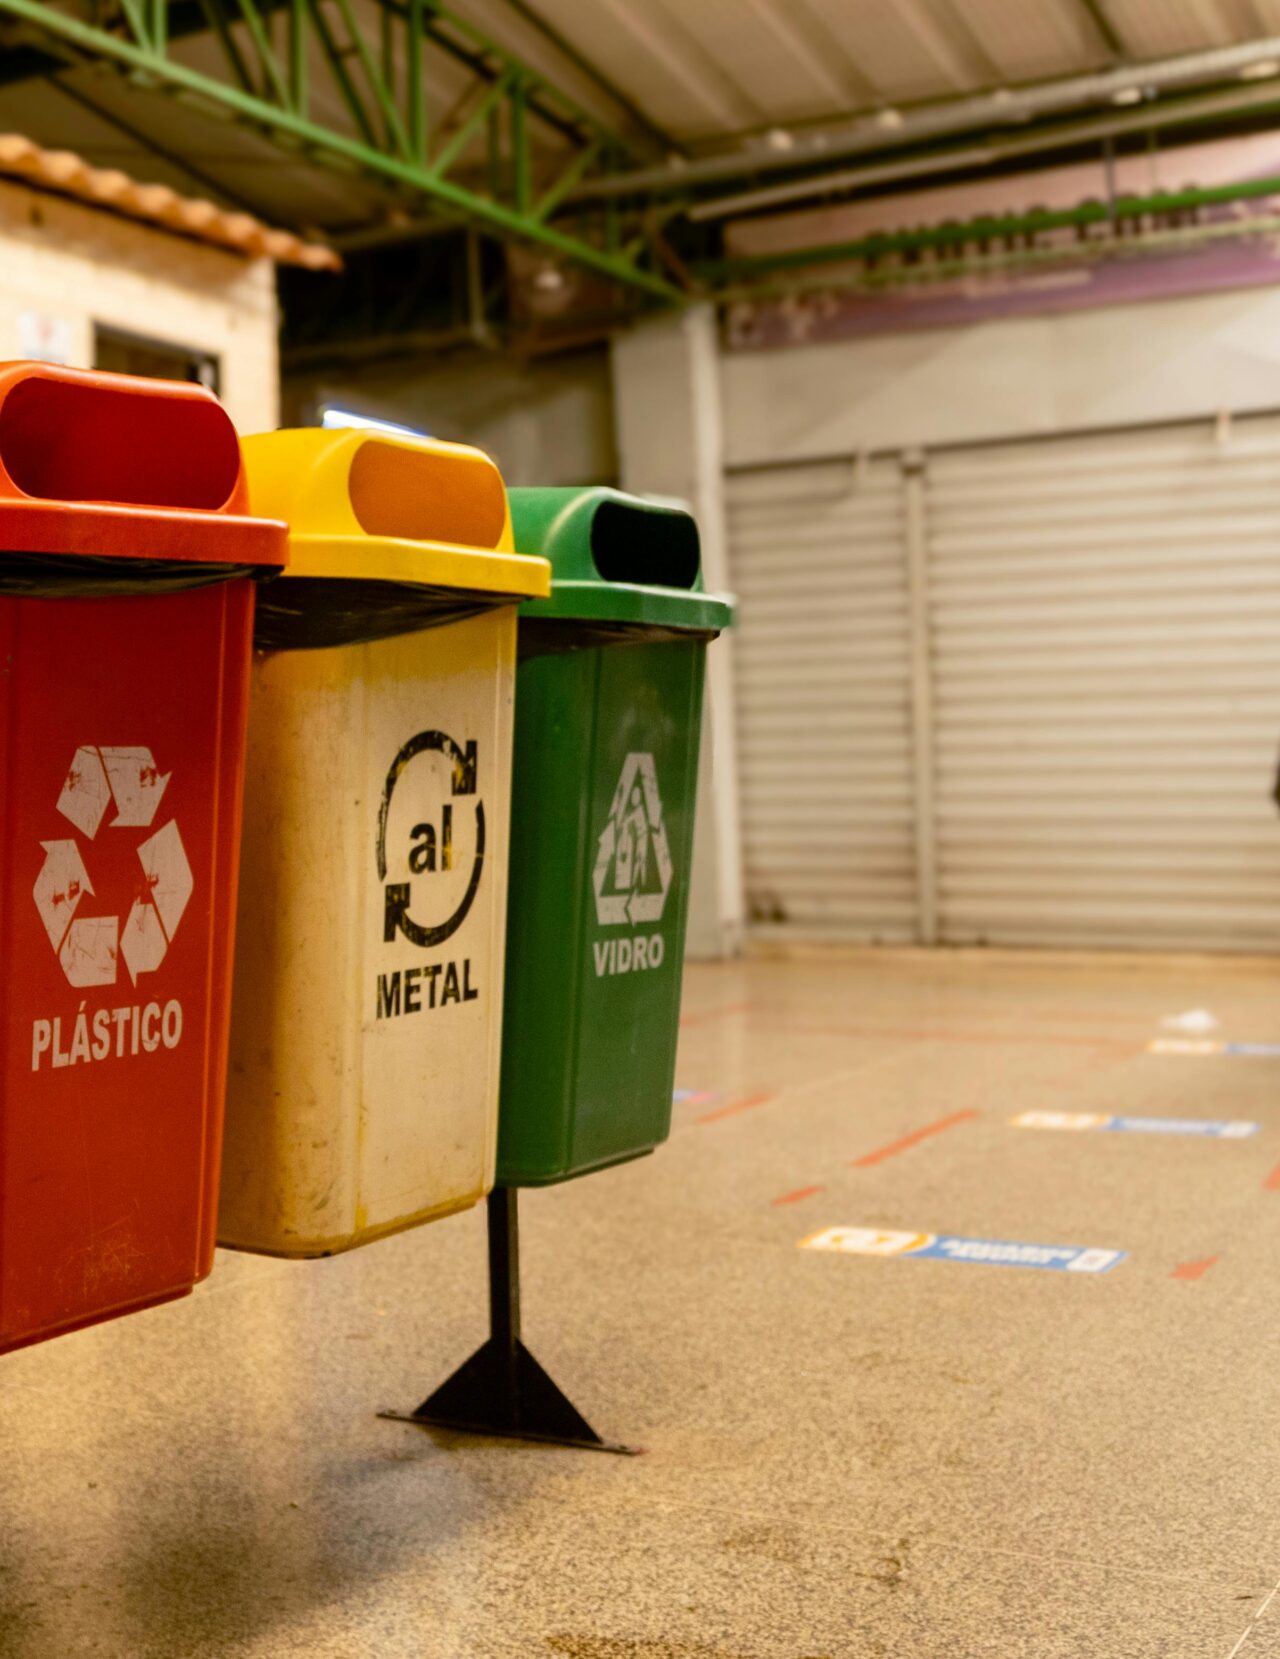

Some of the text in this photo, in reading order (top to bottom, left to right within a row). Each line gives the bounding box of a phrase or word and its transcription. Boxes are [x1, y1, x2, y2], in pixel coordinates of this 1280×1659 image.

[408, 804, 453, 875] al
[376, 958, 479, 1019] METAL
[593, 934, 664, 977] VIDRO
[31, 999, 183, 1071] PLÁSTICO
